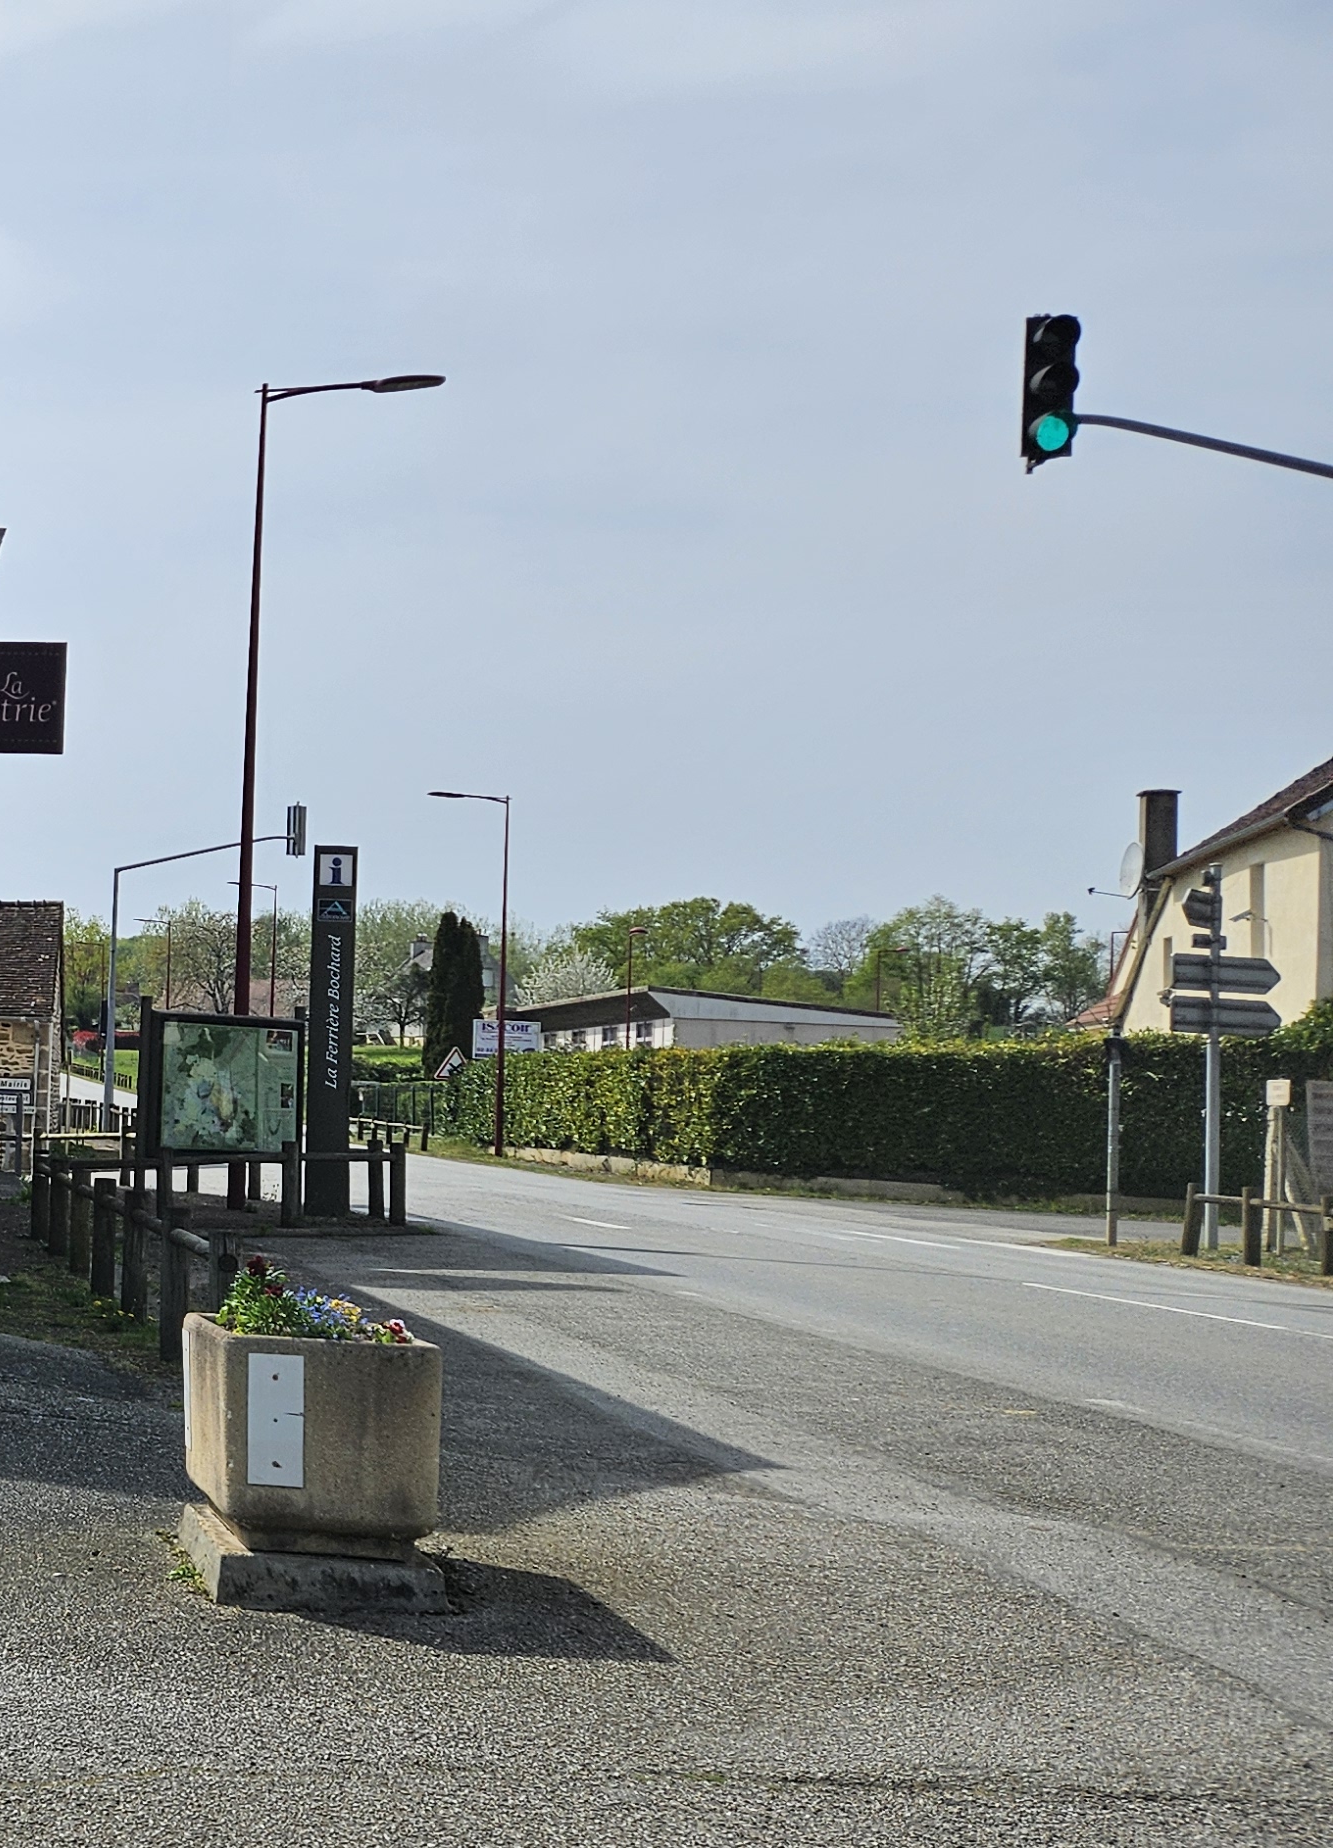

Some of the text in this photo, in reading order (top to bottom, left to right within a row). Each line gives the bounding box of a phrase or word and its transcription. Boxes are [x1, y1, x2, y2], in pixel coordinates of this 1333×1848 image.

[327, 934, 342, 1000] Bochard
[325, 1003, 341, 1065] Ferrière
[0, 1080, 28, 1088] Mairie
[325, 1069, 338, 1089] La
